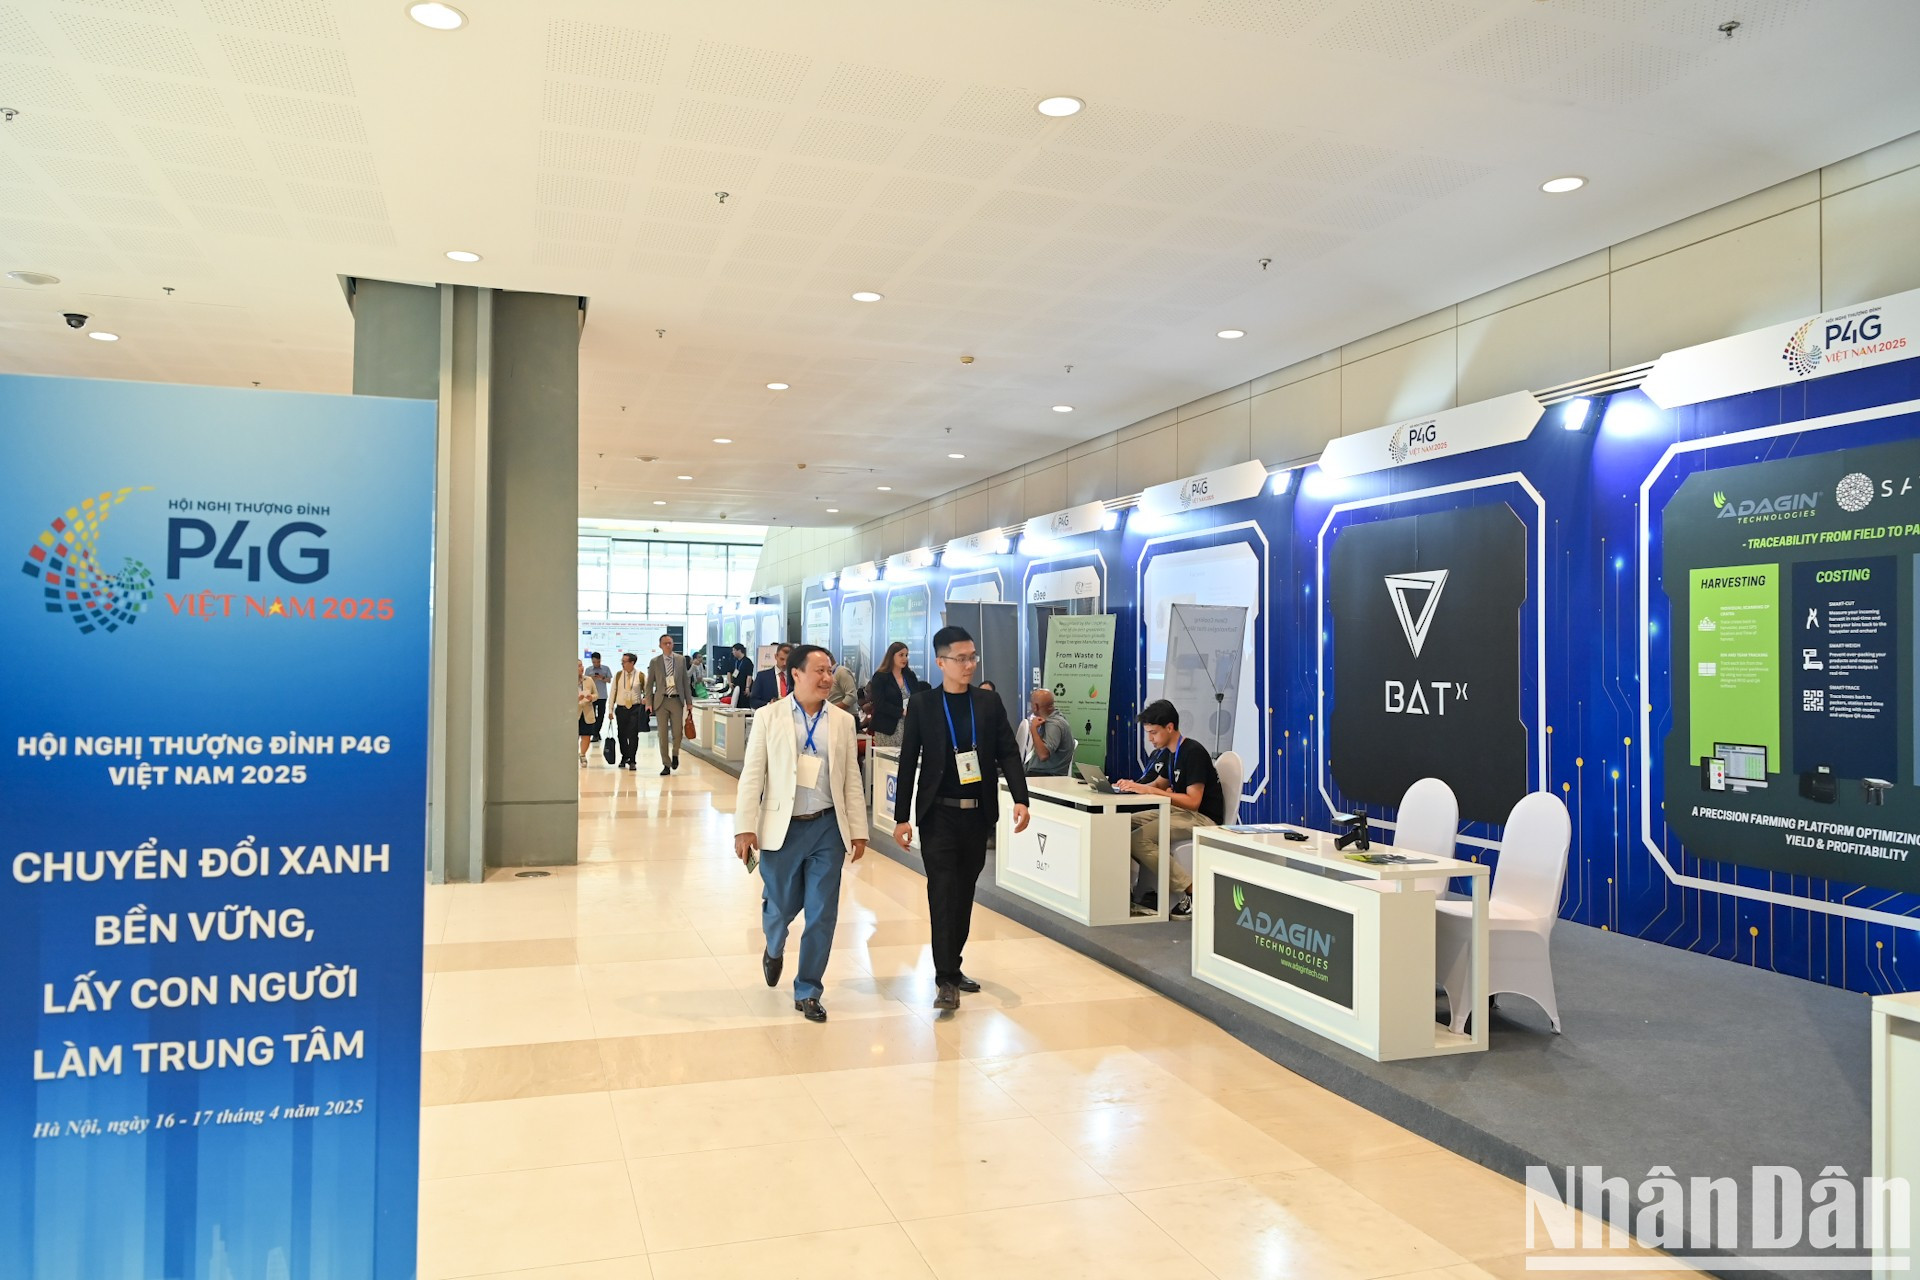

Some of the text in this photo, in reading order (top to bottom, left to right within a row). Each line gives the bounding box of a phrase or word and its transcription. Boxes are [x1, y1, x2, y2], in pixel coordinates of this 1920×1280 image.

[1826, 315, 1881, 349] P4G
[1825, 338, 1906, 362] VIỆT NAM 2025
[1410, 425, 1435, 446] P4G
[1881, 475, 1920, 497] SA
[169, 498, 192, 512] HỘI
[197, 501, 230, 514] NGHỊ
[235, 502, 292, 516] THƯỢNG
[1717, 492, 1818, 518] ADAGIN
[1738, 510, 1816, 524] TECHNOLOGIES
[167, 518, 330, 584] P4G
[1748, 533, 1818, 549] TRACEABILITY
[1820, 530, 1851, 543] FROM
[1854, 527, 1885, 540] FIELD
[1888, 525, 1902, 537] TO
[1700, 575, 1766, 589] HARVESTING
[1816, 568, 1871, 583] COSTING
[164, 590, 395, 622] VIỆT NAM 2025
[17, 730, 391, 760] HỘI NGHỊ THƯỢNG ĐỈNH P4G
[109, 762, 307, 790] VIỆT NAM 2025
[1692, 806, 1699, 816] A
[1700, 807, 1750, 824] PRECISION
[1751, 814, 1796, 830] FARMING
[1798, 819, 1854, 837] PLATFORM
[12, 835, 390, 884] CHUYỂN ĐỔI XANH
[1785, 834, 1908, 862] YIELD & PROFITABILITY
[95, 903, 315, 946] BỀN VỮNG,
[1236, 907, 1331, 957] ADAGIN
[1255, 935, 1328, 970] TECHNOLOGIES
[1280, 959, 1328, 982] www.adagintech.com
[44, 963, 358, 1014] LẤY CON NGƯỜI
[33, 1025, 365, 1080] LÀM TRUNG TÂM
[33, 1122, 60, 1138] Hà
[65, 1118, 102, 1139] Nội,
[108, 1117, 150, 1135] ngày
[155, 1113, 175, 1128] 16
[192, 1110, 213, 1125] 17
[217, 1108, 264, 1126] tháng
[269, 1105, 280, 1119] 4
[284, 1103, 319, 1118] năm
[324, 1099, 364, 1115] 2025
